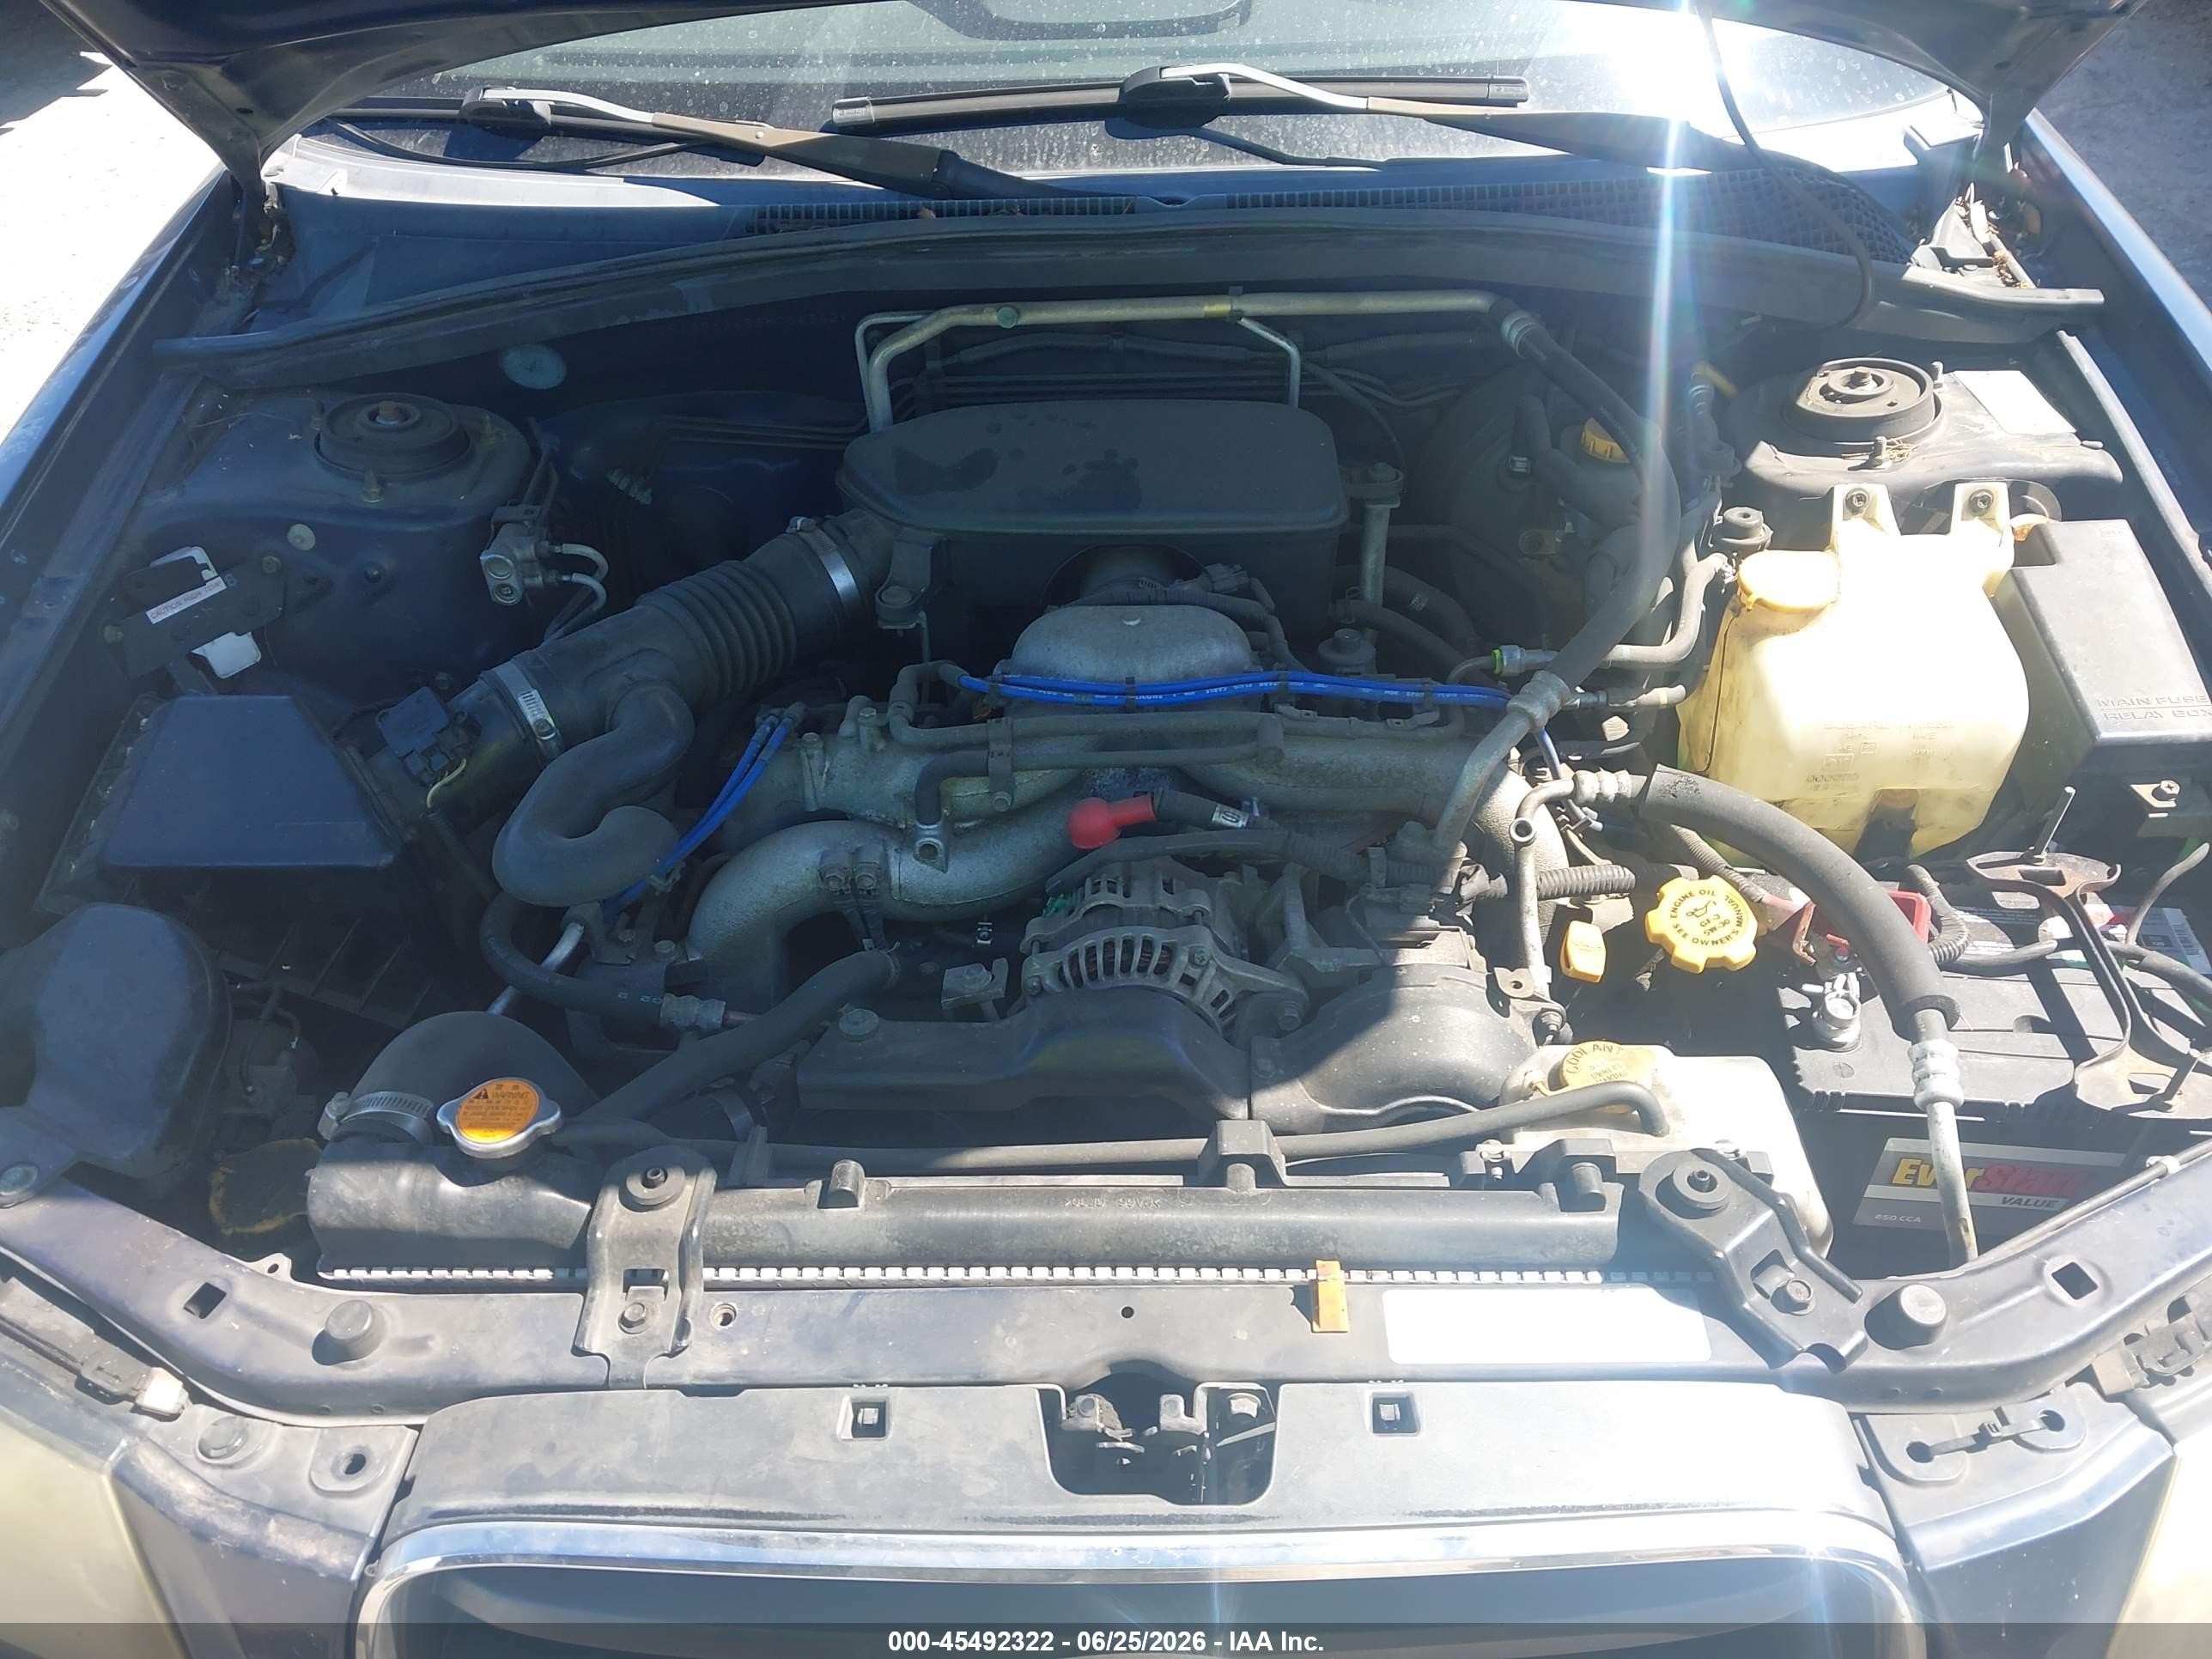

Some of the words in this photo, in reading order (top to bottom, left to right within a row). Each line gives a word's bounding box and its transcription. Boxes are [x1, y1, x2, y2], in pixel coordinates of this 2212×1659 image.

[2097, 696, 2150, 708] MAIN
[2156, 695, 2209, 704] FUSE
[2104, 710, 2164, 720] RELAY
[1670, 890, 1695, 918] ENGINE
[1673, 923, 1689, 939] SEE
[1692, 928, 1739, 945] OWNER'S
[1724, 895, 1743, 927] MANUAL
[2002, 1196, 2059, 1209] VALUE
